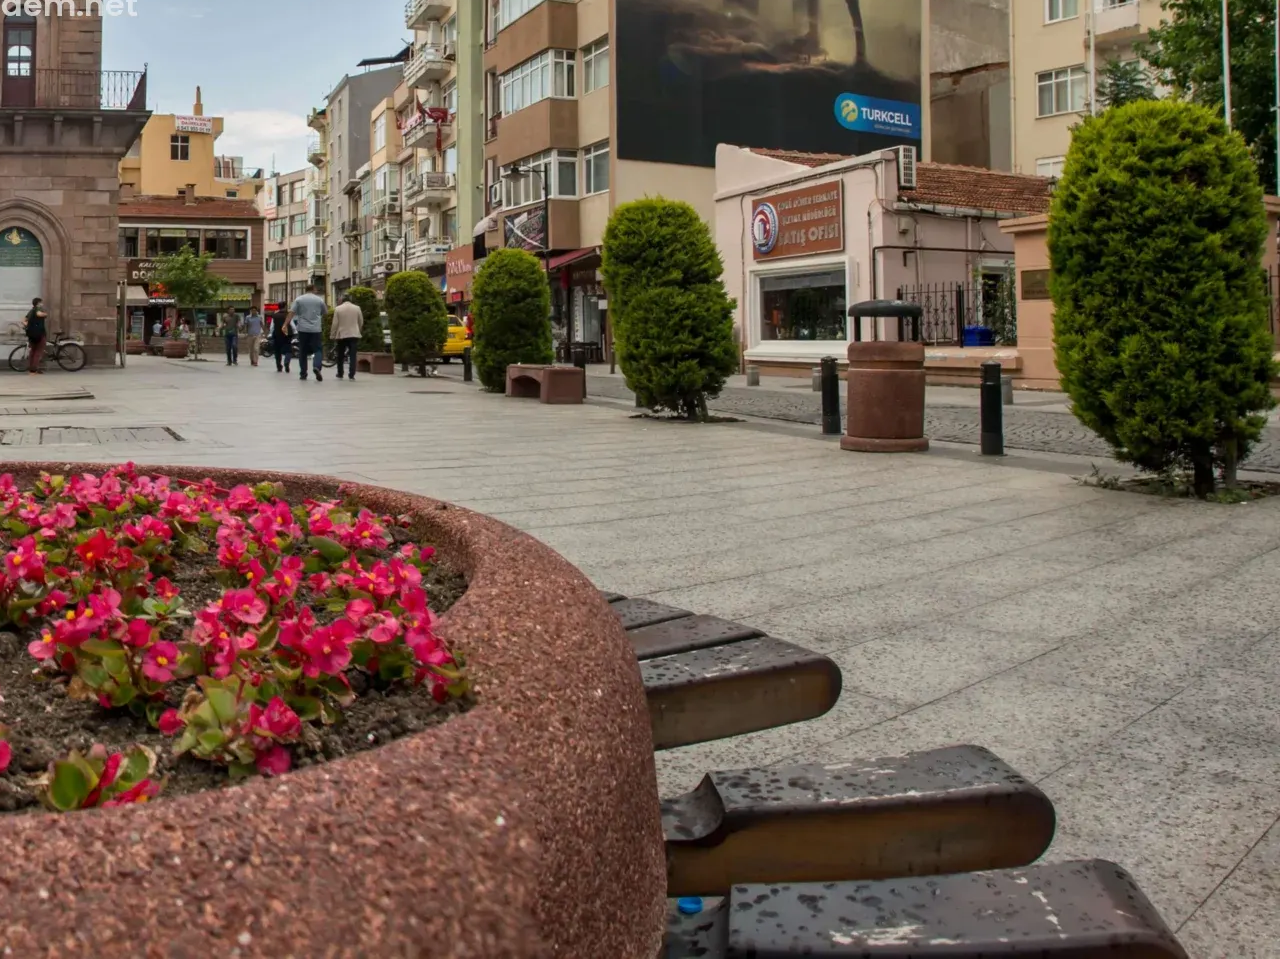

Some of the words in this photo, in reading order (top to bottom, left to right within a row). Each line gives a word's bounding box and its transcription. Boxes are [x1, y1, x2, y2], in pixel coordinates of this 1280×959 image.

[860, 107, 912, 126] TURKCELL
[778, 228, 806, 246] SATIŞ
[808, 224, 839, 241] OFİSİ
